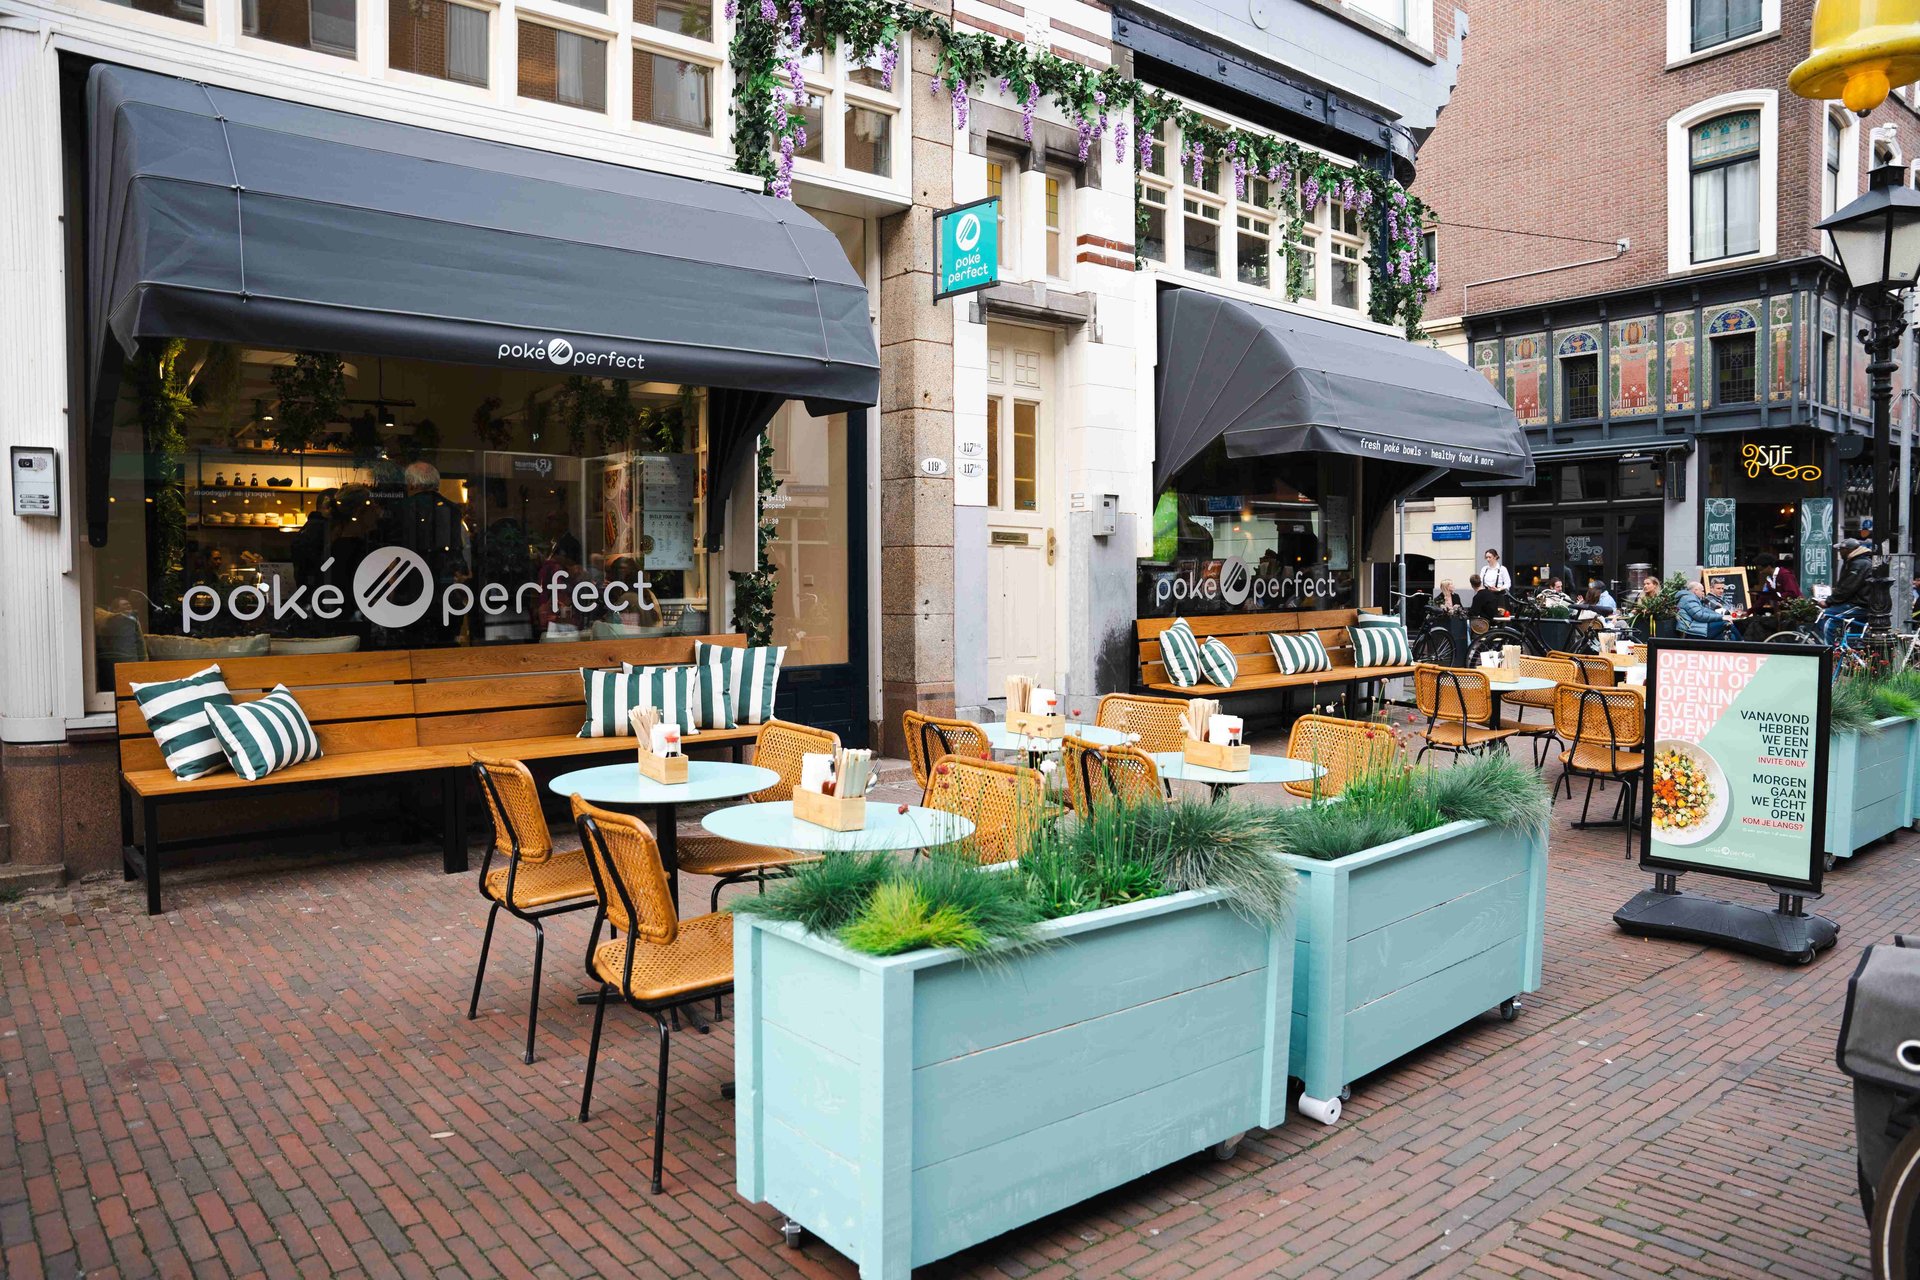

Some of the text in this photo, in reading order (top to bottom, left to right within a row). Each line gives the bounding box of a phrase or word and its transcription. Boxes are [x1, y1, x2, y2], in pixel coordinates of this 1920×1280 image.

[955, 248, 980, 270] poké
[948, 263, 989, 286] perfect
[498, 339, 645, 370] poké perfect
[1360, 438, 1380, 450] fresh
[1383, 443, 1400, 453] poké
[1402, 445, 1421, 456] bowls
[1431, 449, 1456, 463] healthy
[1458, 452, 1472, 463] food
[1480, 457, 1494, 466] more
[1708, 554, 1730, 566] LUNCH
[1805, 548, 1827, 561] BIER
[1156, 562, 1336, 607] poké perfect
[182, 556, 655, 633] poké perfect
[1660, 652, 1749, 673] OPENING
[1659, 668, 1723, 688] EVENT
[1658, 701, 1722, 720] EVENT
[1740, 710, 1809, 724] VANAVOND
[1657, 717, 1717, 736] OPEN
[1759, 722, 1809, 736] HEBBEN
[1762, 734, 1808, 747] WE EEN
[1767, 746, 1808, 759] EVENT
[1758, 756, 1805, 768] INVITE ONLY
[1752, 773, 1807, 788] MORGEN
[1770, 787, 1806, 799] GAAN
[1751, 795, 1806, 810] WE ÉCHT
[1771, 809, 1805, 822] OPEN
[1742, 817, 1803, 831] KOM JE LANGS?
